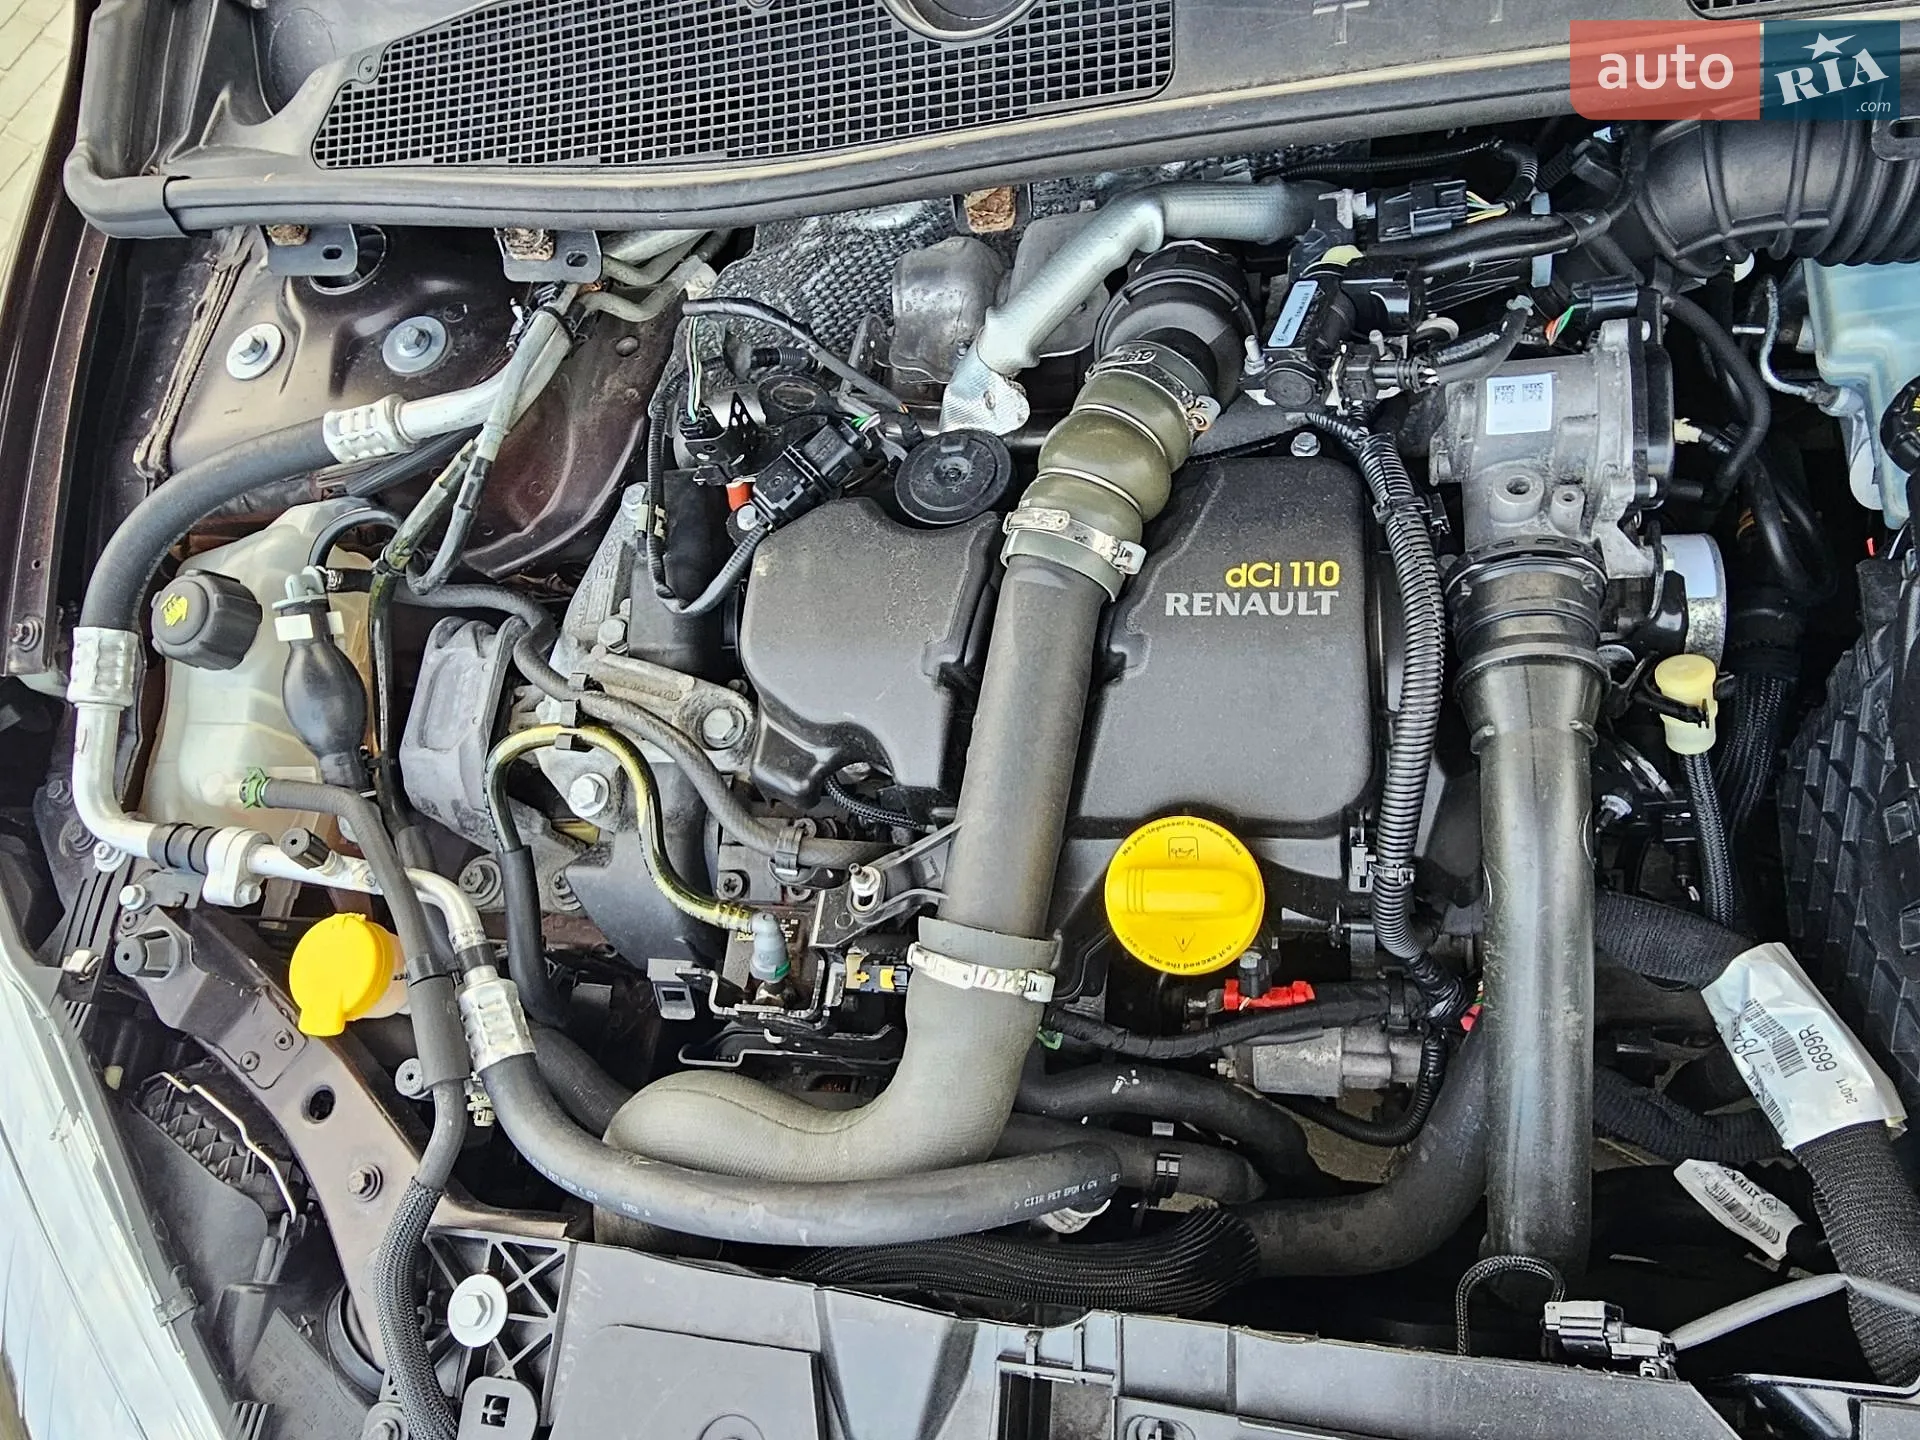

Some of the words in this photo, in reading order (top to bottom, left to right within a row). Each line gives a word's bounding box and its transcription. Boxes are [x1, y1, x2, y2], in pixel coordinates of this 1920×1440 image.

[1225, 562, 1281, 588] dCi
[1289, 560, 1340, 588] 110
[1164, 591, 1340, 617] RENAULT
[1798, 1023, 1838, 1072] 6699R
[1835, 1077, 1858, 1105] 24011
